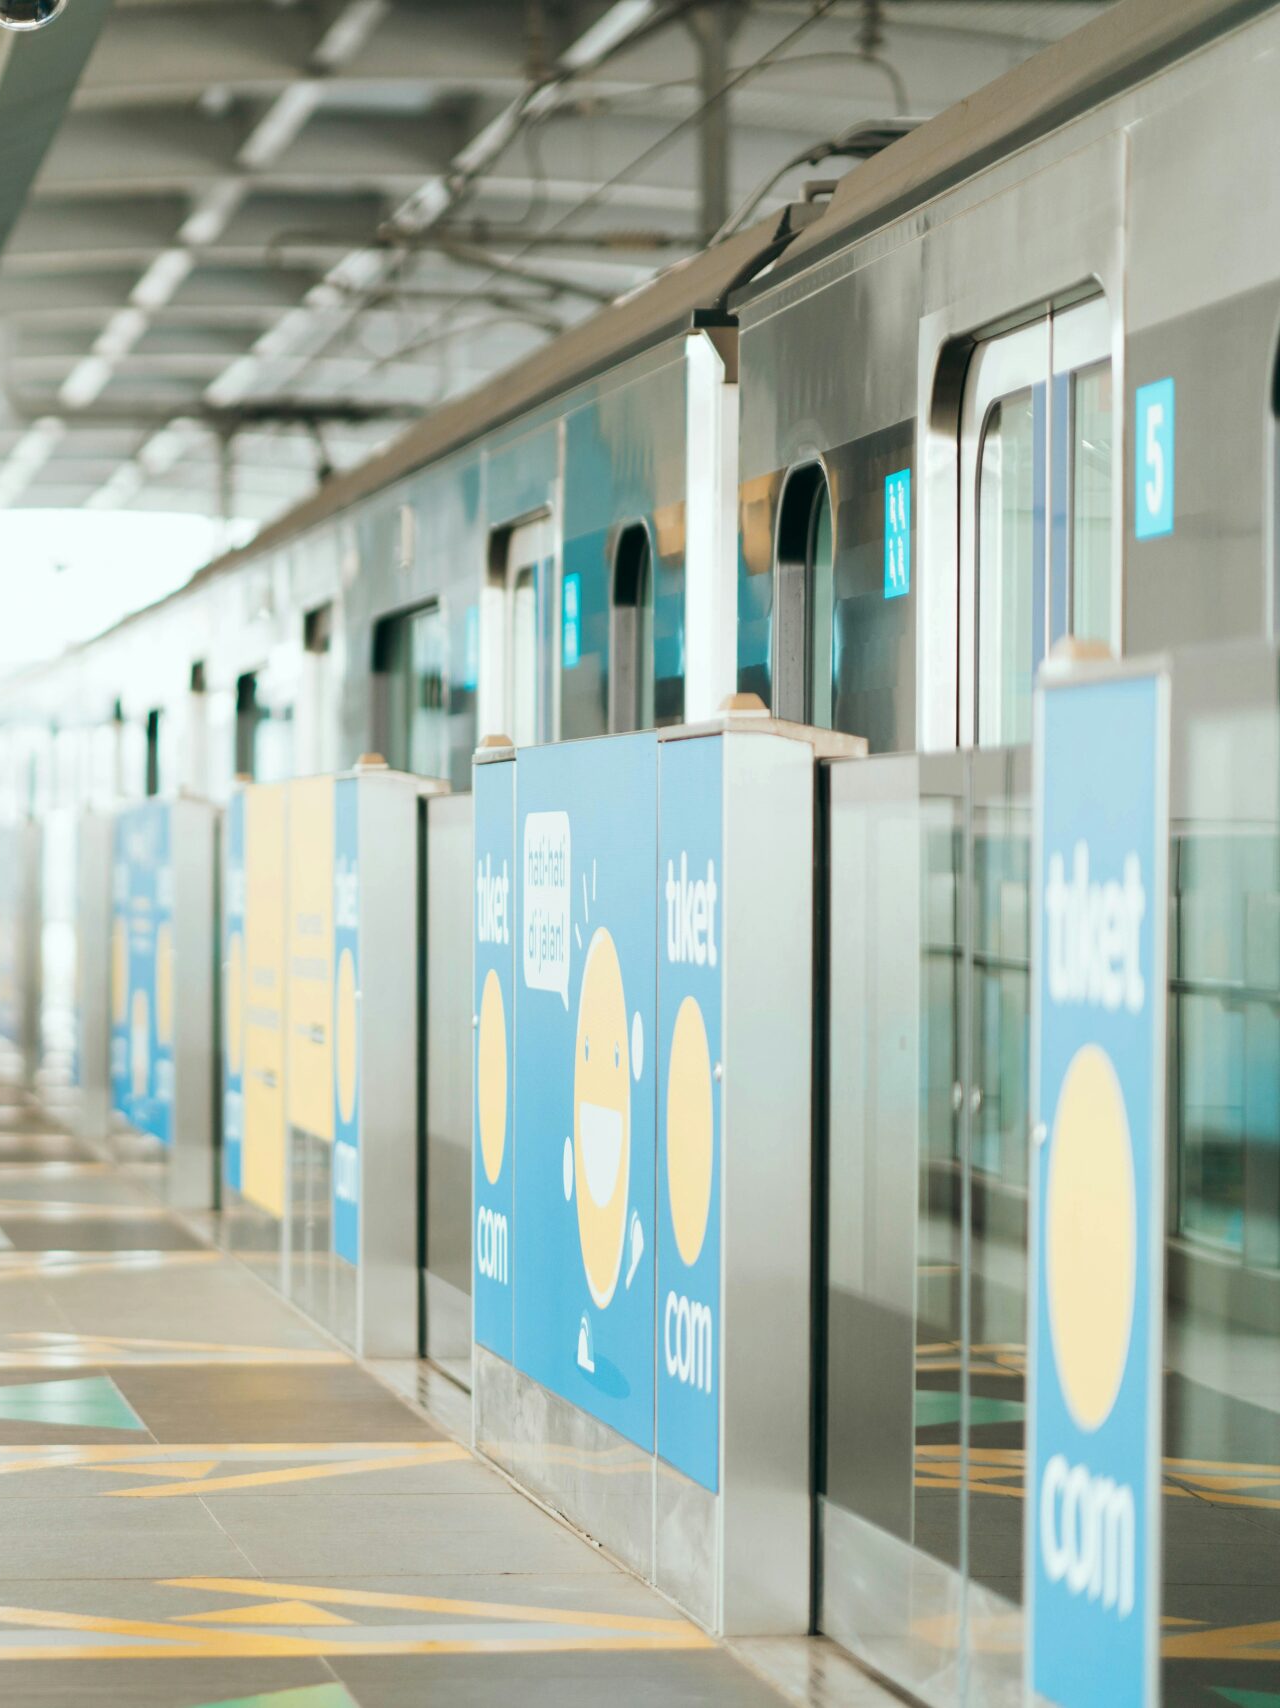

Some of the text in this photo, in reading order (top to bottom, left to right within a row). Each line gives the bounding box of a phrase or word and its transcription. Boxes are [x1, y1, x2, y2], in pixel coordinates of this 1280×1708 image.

[1145, 403, 1164, 517] 5
[477, 852, 509, 944] tiket
[528, 834, 565, 888] hati-hati
[665, 849, 717, 968] tiket
[528, 908, 565, 974] di jalan!
[477, 1205, 508, 1286] com
[664, 1290, 712, 1394] com
[1040, 1452, 1136, 1622] com
